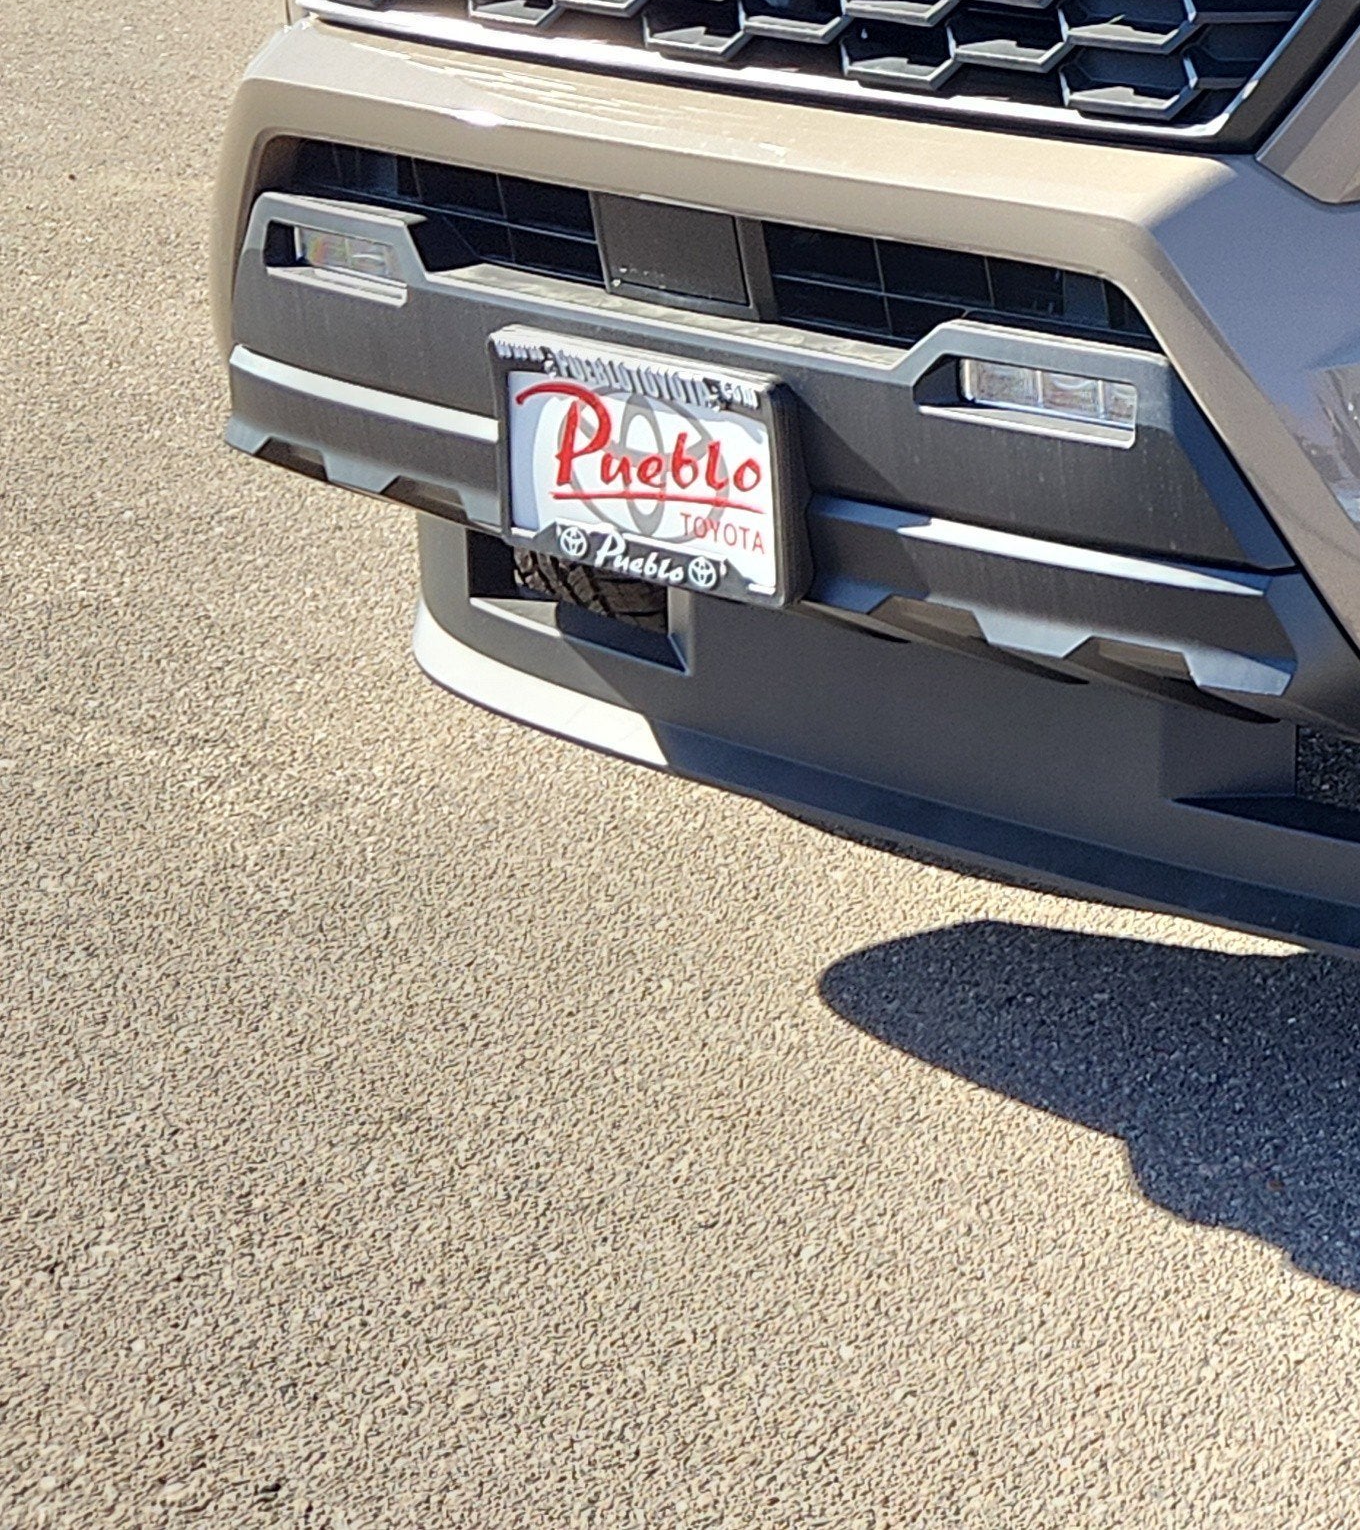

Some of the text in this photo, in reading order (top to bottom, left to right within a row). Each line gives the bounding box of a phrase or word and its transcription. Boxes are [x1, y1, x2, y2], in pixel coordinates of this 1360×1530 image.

[515, 379, 763, 493] Pueblo
[594, 528, 685, 584] Pueblo
[679, 511, 766, 556] TOYOTA
